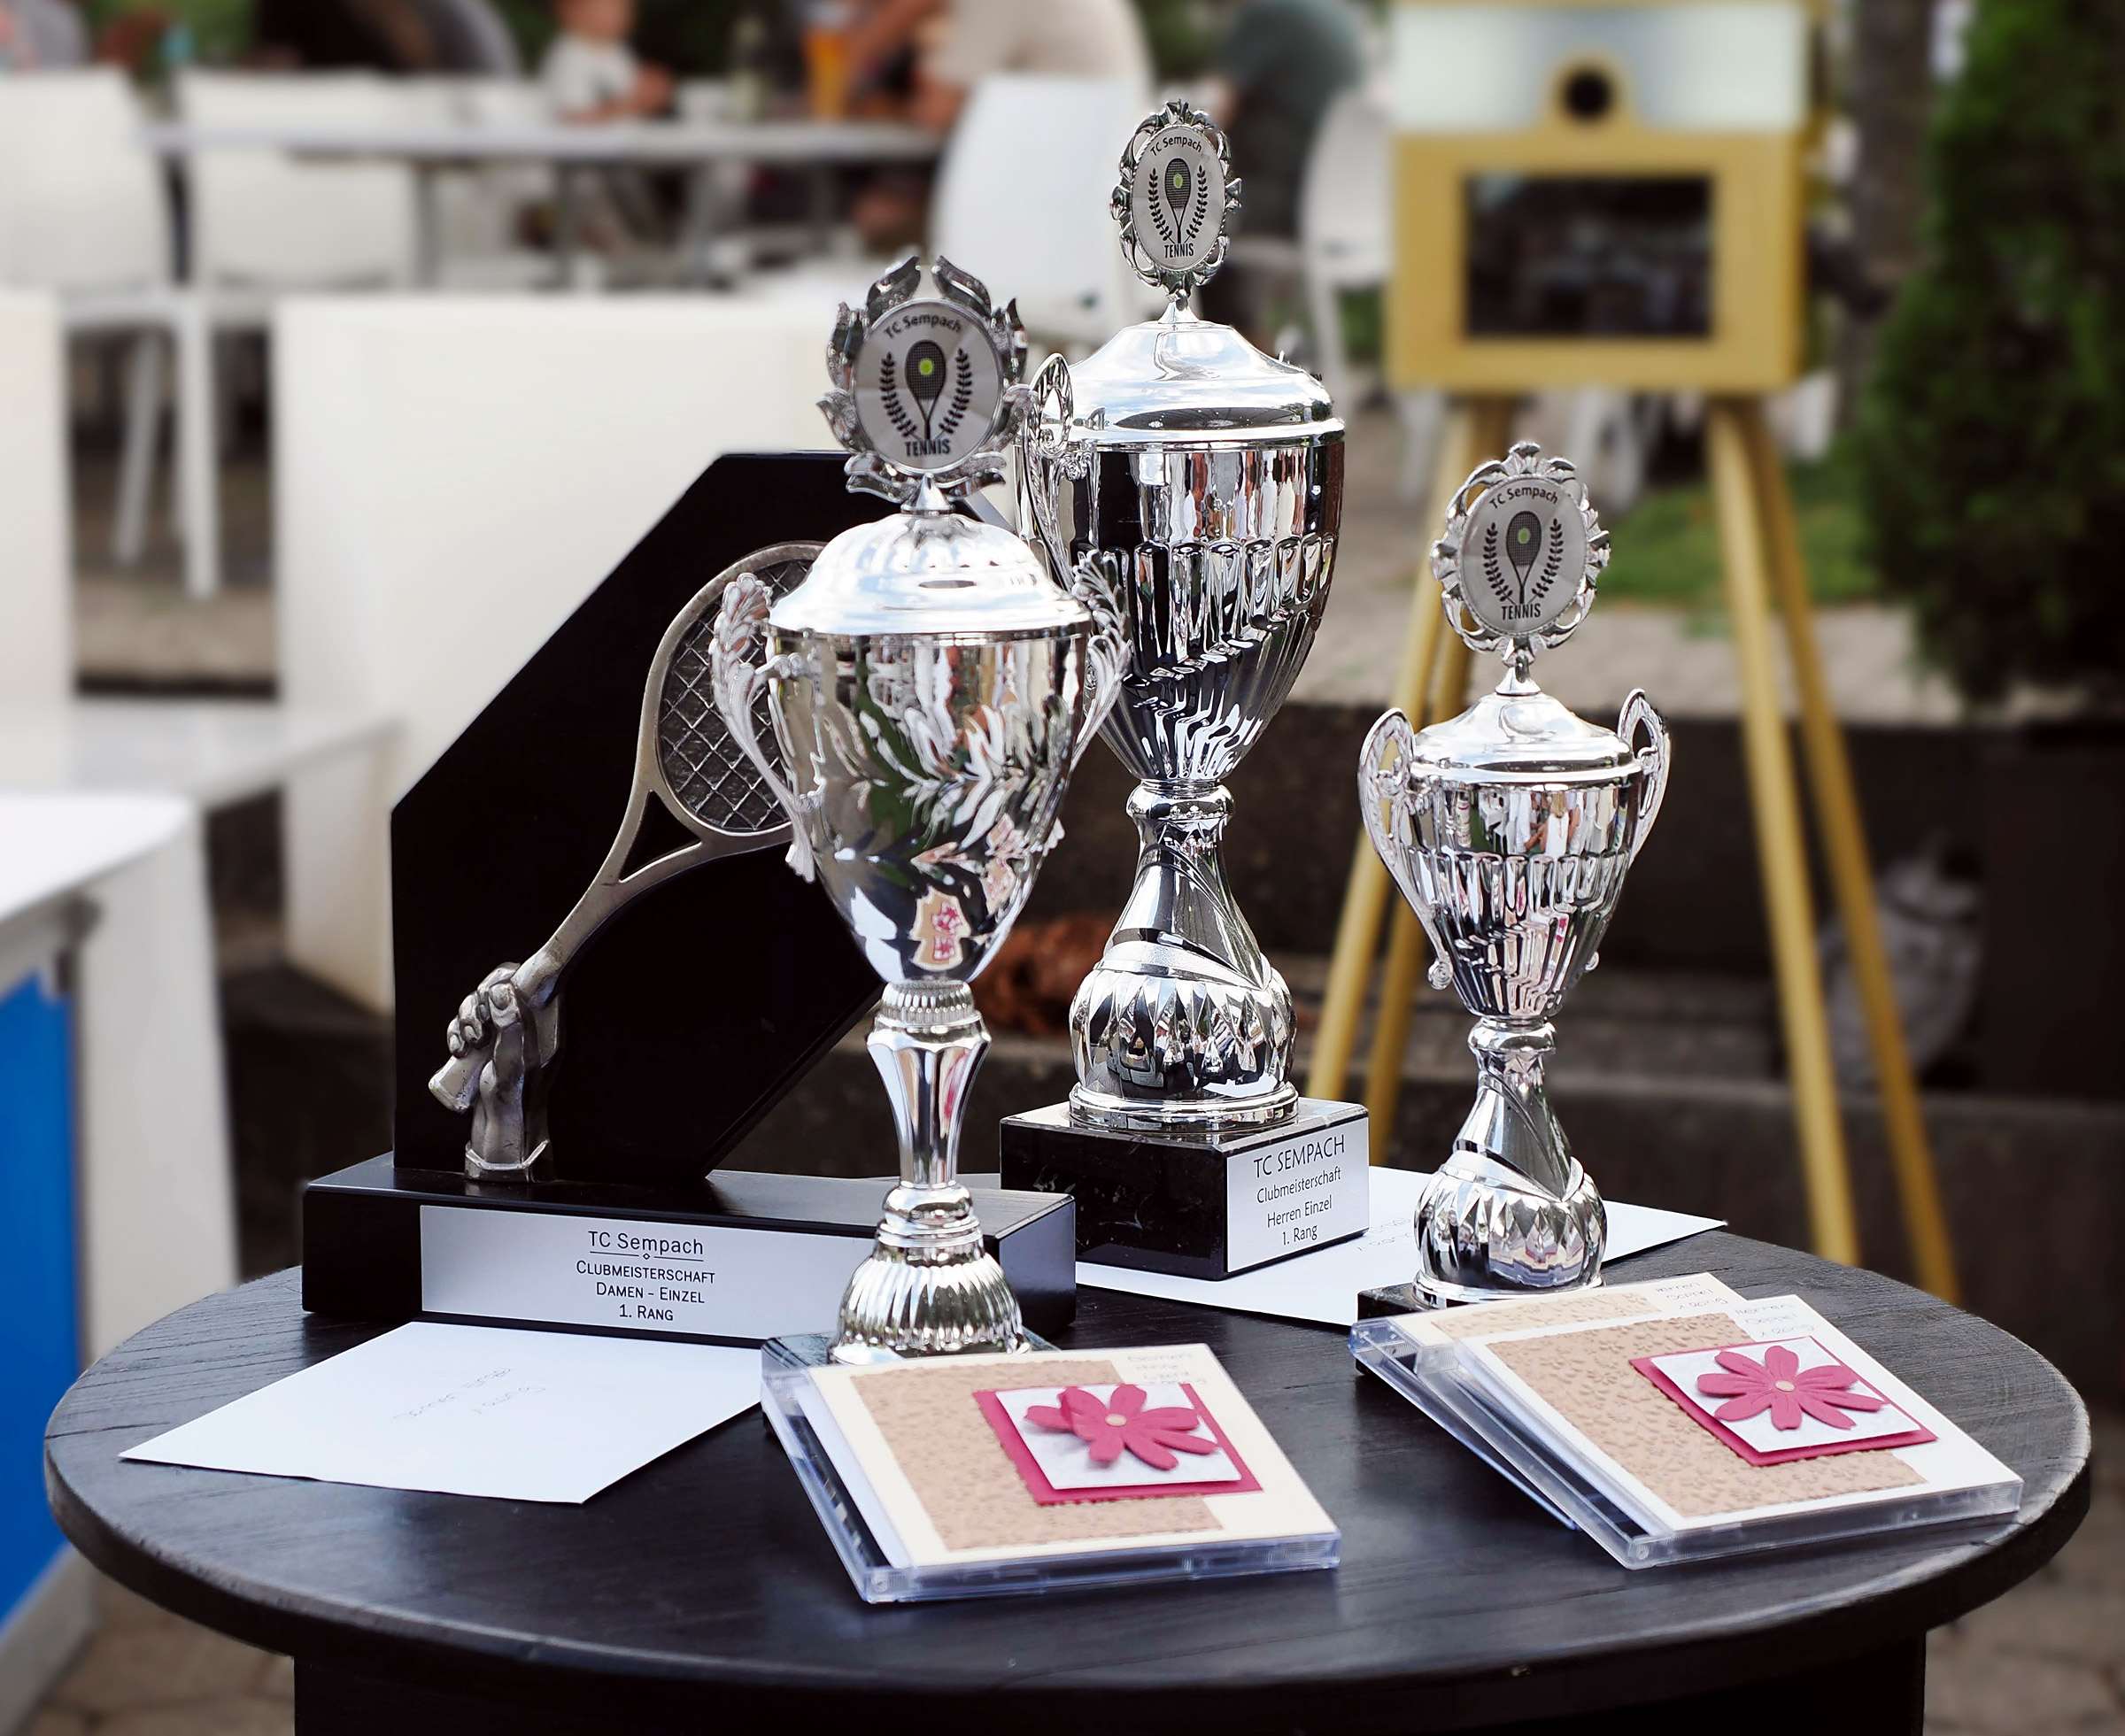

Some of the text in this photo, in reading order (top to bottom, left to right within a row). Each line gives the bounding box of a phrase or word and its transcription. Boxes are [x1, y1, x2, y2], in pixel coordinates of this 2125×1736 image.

[1150, 136, 1202, 156] TC Sempach
[1164, 243, 1194, 258] TENNIS
[884, 314, 962, 338] TC Sempach
[904, 438, 951, 457] TENNIS
[1488, 487, 1558, 509] TC Sempach
[1502, 603, 1541, 620] TENNIS
[1254, 1134, 1345, 1178] TC SEMPACH
[1257, 1166, 1341, 1203] Clubmeisterschaft
[1267, 1194, 1333, 1228] Herren Einzel
[588, 1231, 704, 1255] TC Sempach
[1282, 1225, 1318, 1246] 1. Rang
[576, 1260, 715, 1284] CLUBMEISTERSCHAFT
[597, 1282, 644, 1299] DAMEN
[660, 1287, 705, 1304] EINZEL
[619, 1304, 674, 1322] 1. RANG
